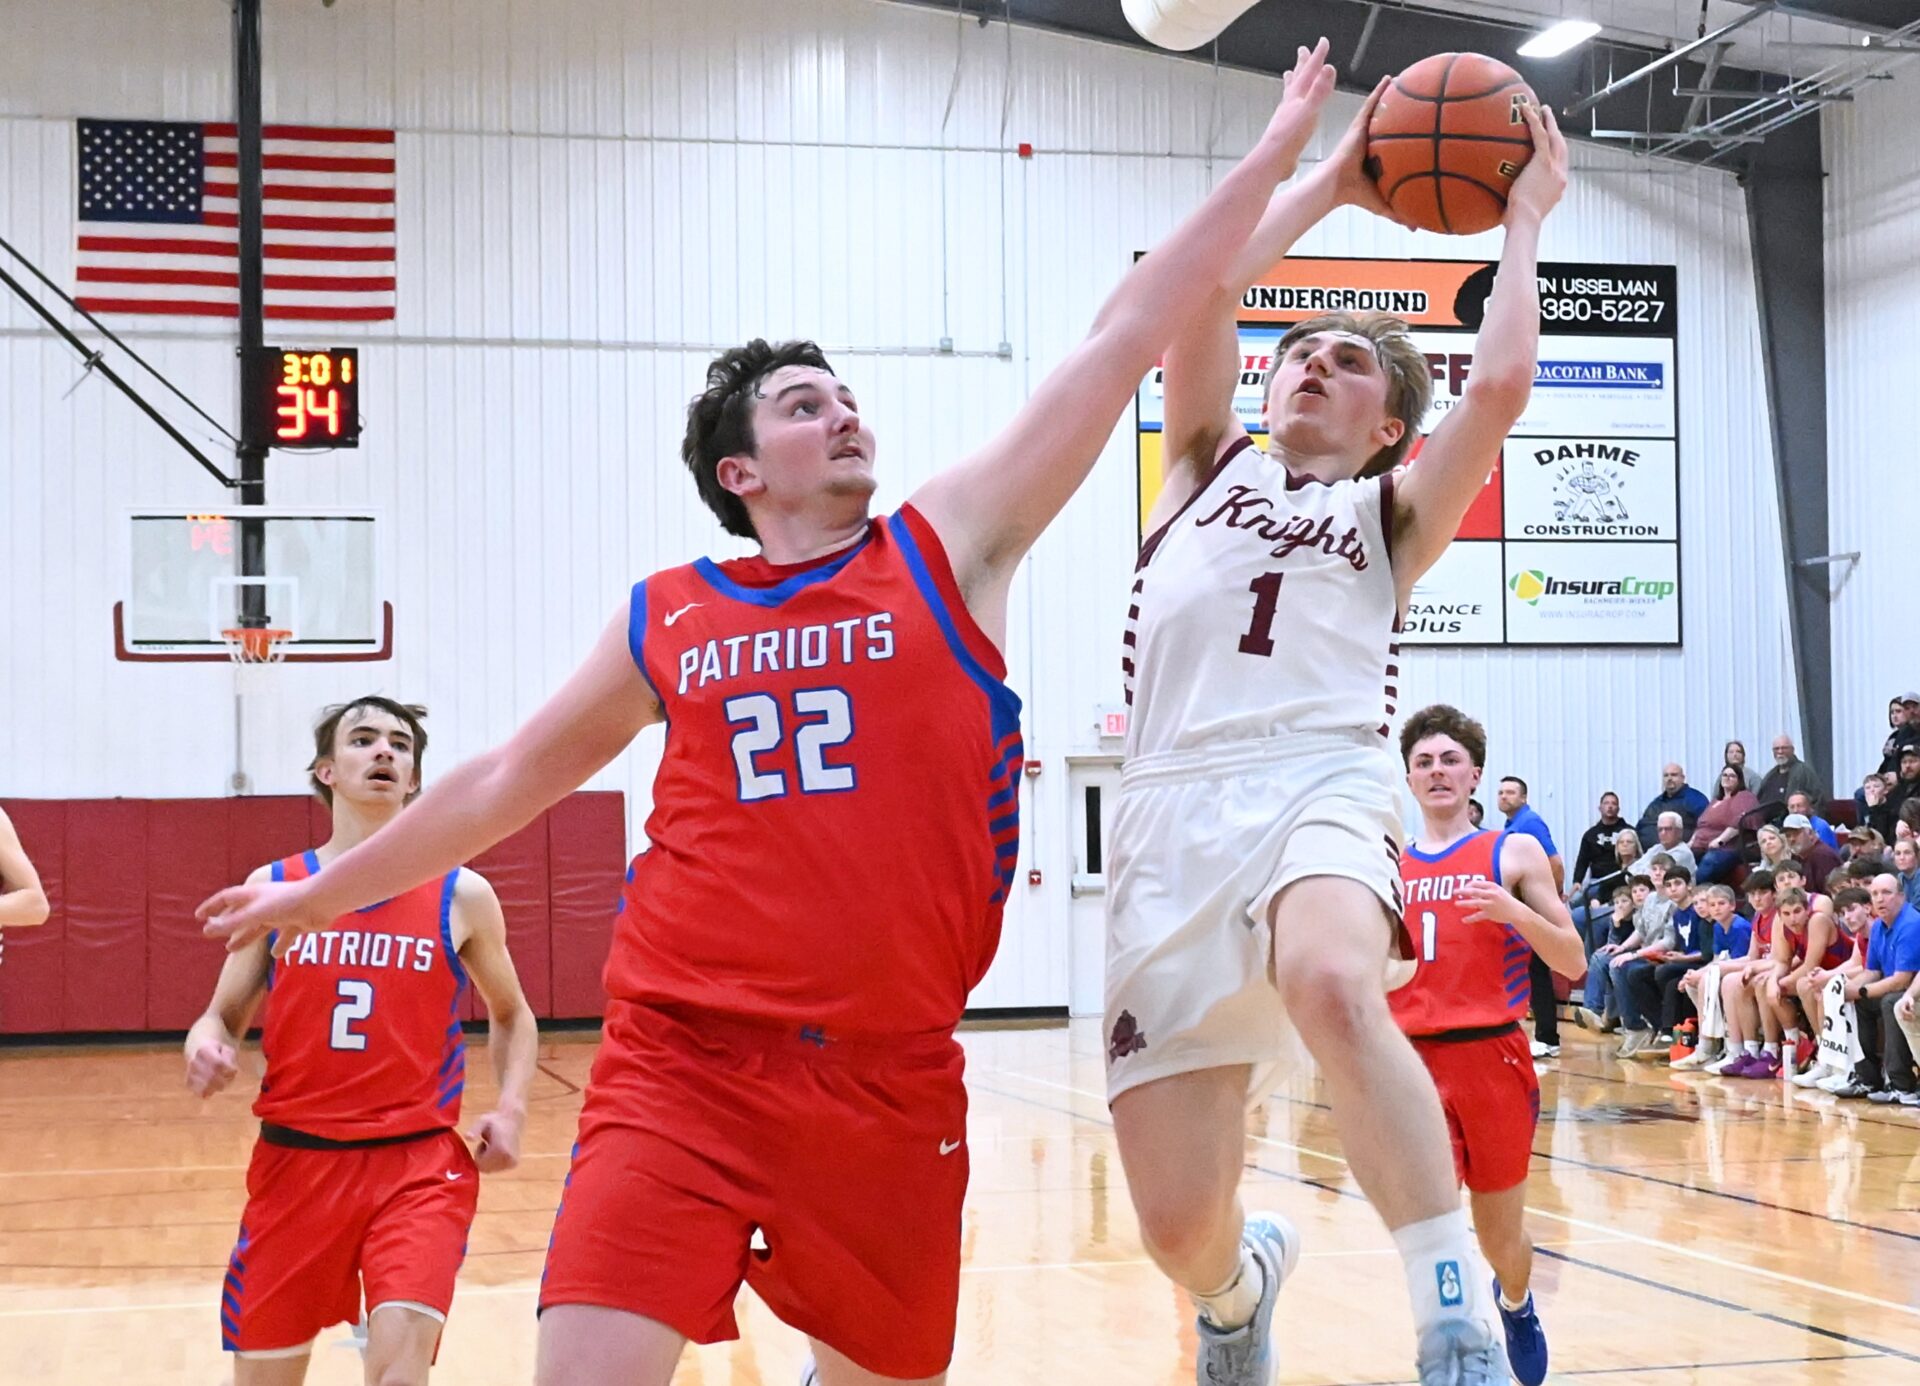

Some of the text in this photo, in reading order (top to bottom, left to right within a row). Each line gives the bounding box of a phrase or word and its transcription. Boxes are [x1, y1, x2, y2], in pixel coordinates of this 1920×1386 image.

[1243, 287, 1427, 312] UNDERGROUND
[1562, 277, 1658, 297] USSELMAN
[1541, 298, 1665, 323] 380-5227
[283, 353, 352, 386] 3:01
[1606, 364, 1648, 380] BANK
[276, 385, 339, 439] 34
[1533, 443, 1641, 467] DAHME
[1195, 485, 1369, 571] Knights
[1523, 524, 1659, 536] CONSTRUCTION
[1545, 576, 1675, 600] InsuraCrop
[1238, 571, 1284, 657] 1
[1408, 604, 1482, 616] RANCE
[678, 611, 895, 695] PATRIOTS
[1106, 713, 1125, 734] EXI
[723, 685, 857, 803] 22
[1421, 910, 1438, 963] 1
[328, 978, 374, 1051] 2
